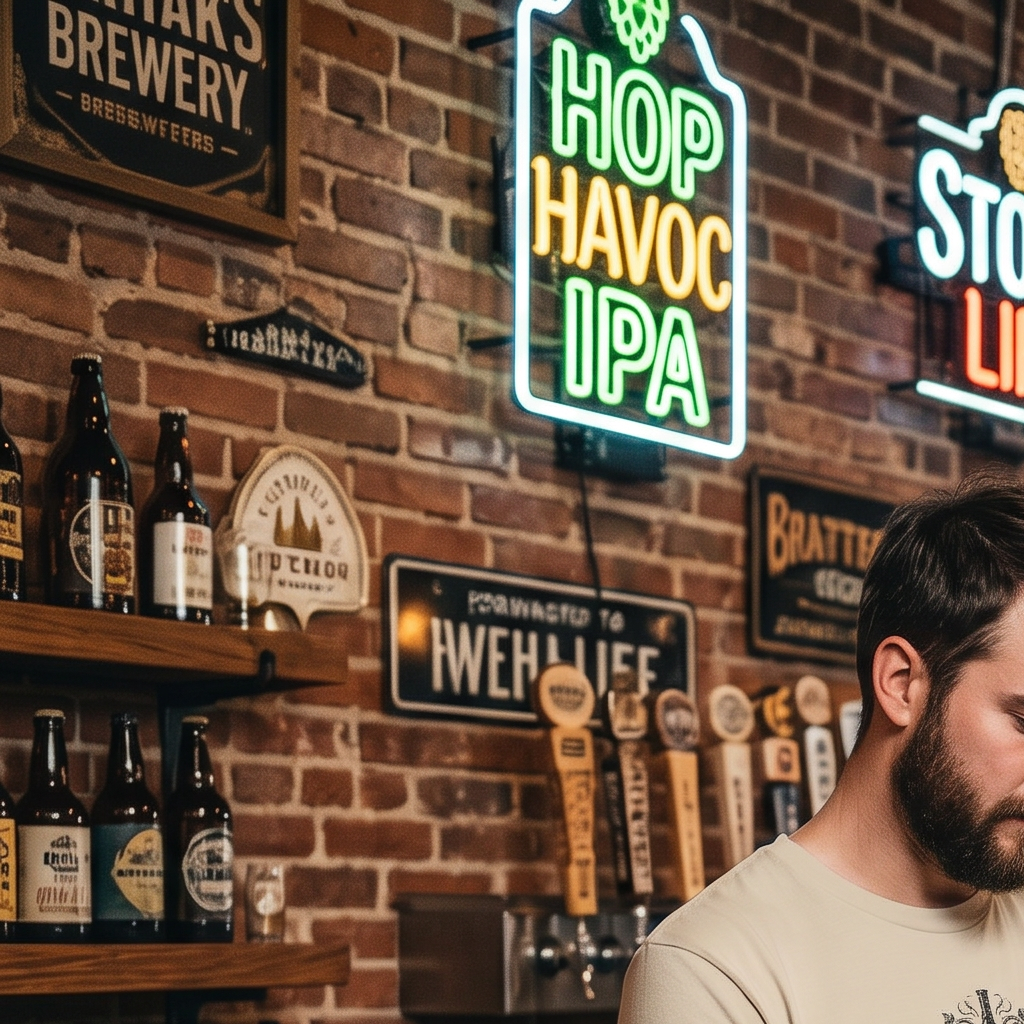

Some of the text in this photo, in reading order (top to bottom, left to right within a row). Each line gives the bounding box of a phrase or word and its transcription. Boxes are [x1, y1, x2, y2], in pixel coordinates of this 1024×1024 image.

[48, 0, 249, 131] BREWERY
[551, 37, 724, 201] HOP
[531, 155, 733, 312] HAVOC
[565, 277, 710, 428] IPA
